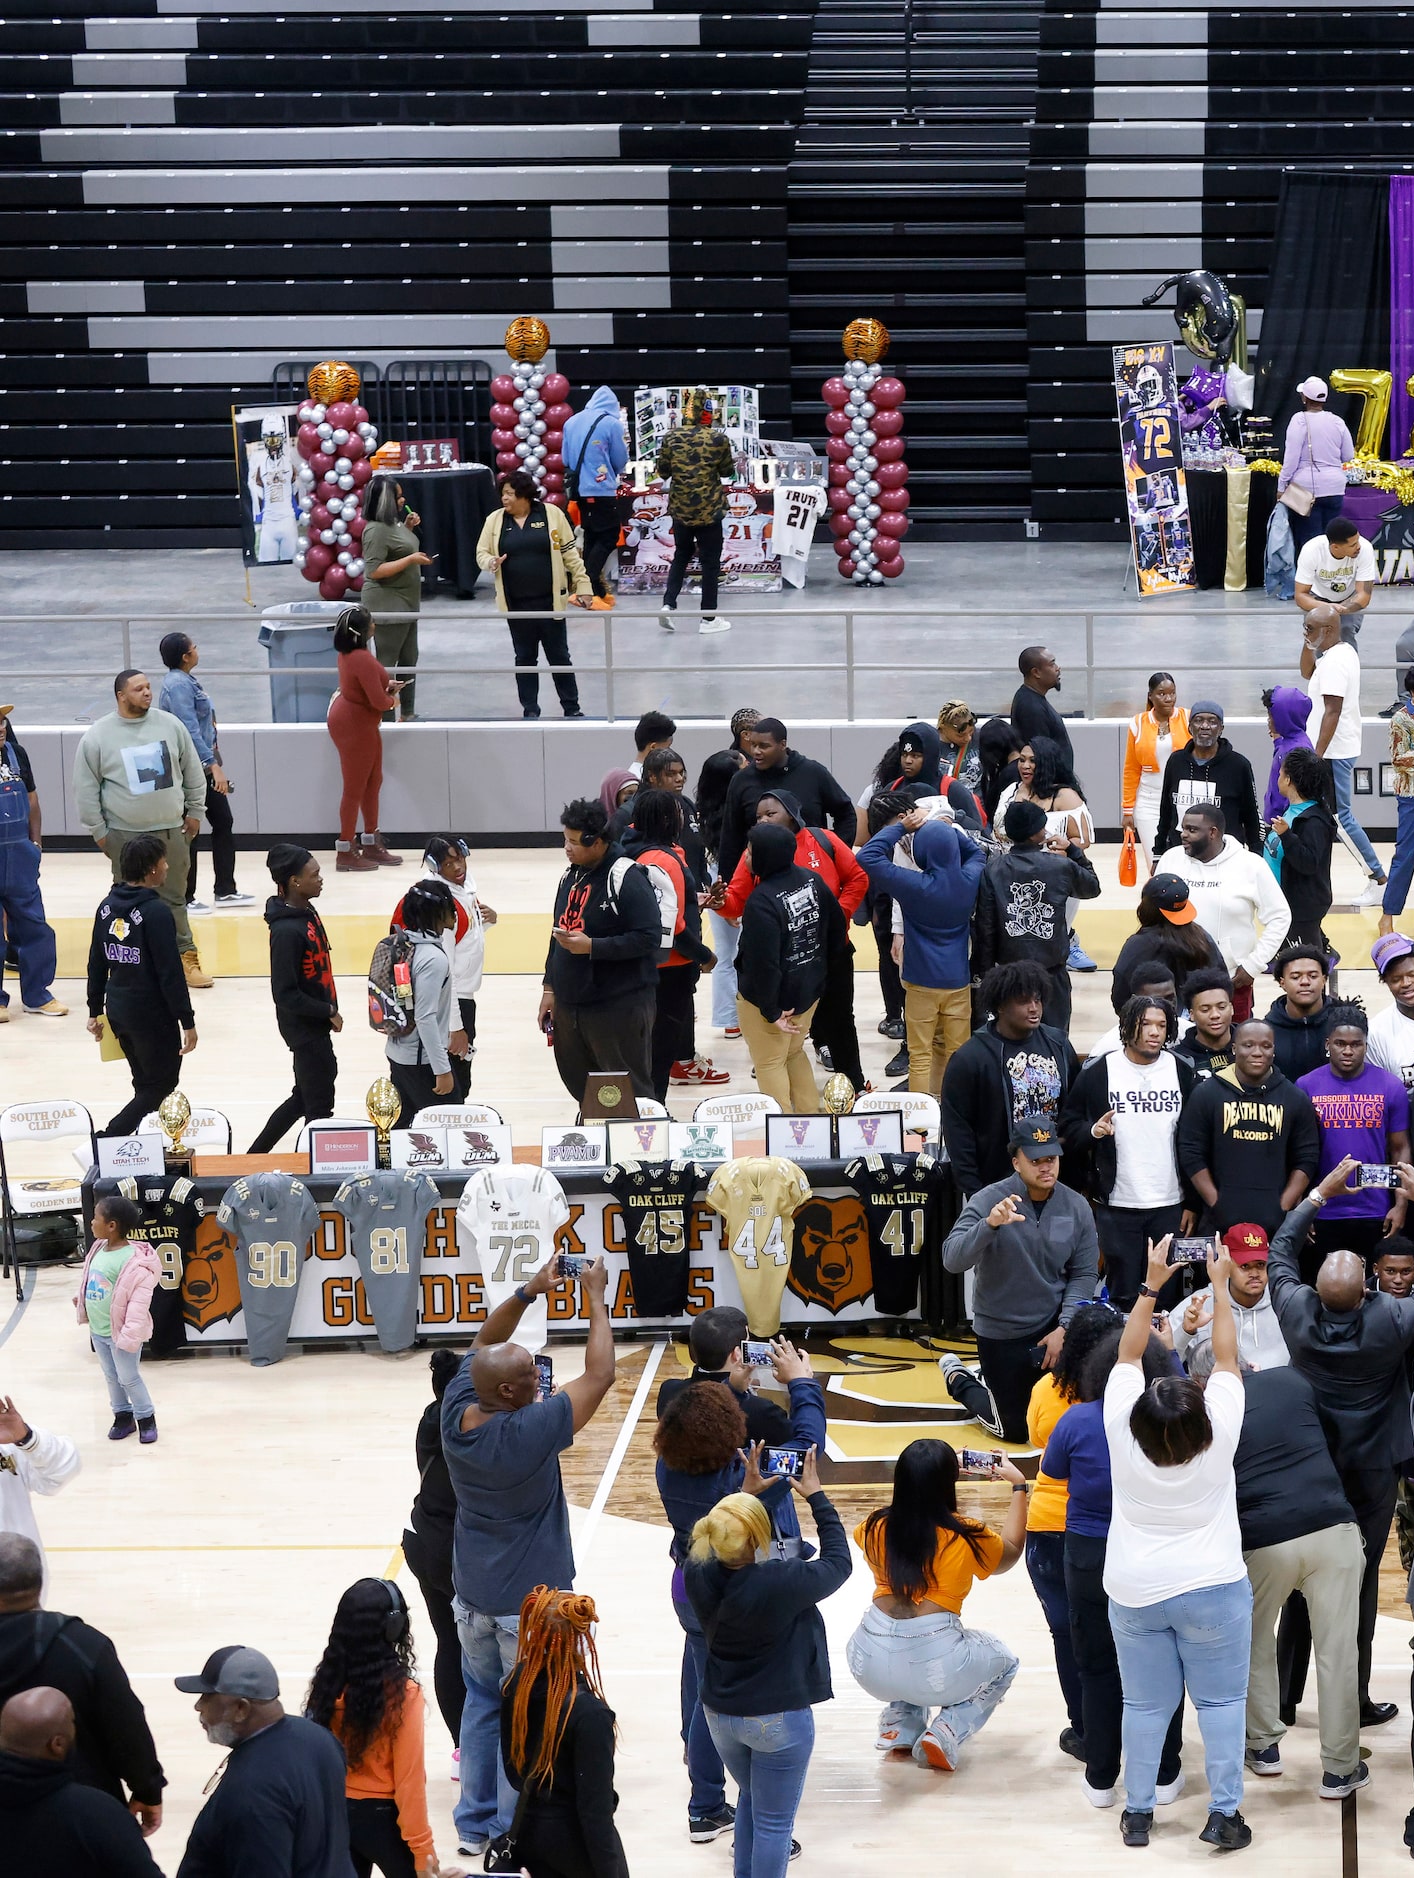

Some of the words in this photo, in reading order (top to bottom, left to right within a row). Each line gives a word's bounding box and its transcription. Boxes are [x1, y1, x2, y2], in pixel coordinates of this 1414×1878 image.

[1139, 416, 1174, 460] 72
[785, 489, 818, 508] TRUTH
[786, 504, 810, 531] 21
[728, 524, 752, 540] 21
[622, 563, 670, 575] TEXA
[1172, 792, 1219, 809] VISIONARY
[1207, 880, 1221, 888] me
[104, 942, 141, 964] LARS
[1110, 1091, 1120, 1102] N
[1126, 1090, 1180, 1102] GLOCK
[1312, 1095, 1352, 1104] MISSOURI
[1353, 1094, 1384, 1103] VALLEY
[640, 1106, 656, 1116] AK
[706, 1103, 742, 1116] SOUTH
[745, 1101, 769, 1112] OAK
[862, 1099, 900, 1110] SOUTH
[904, 1101, 928, 1111] OAK
[1130, 1101, 1181, 1113] TRUST
[10, 1111, 49, 1123] SOUTH
[52, 1108, 78, 1119] OAK
[422, 1113, 460, 1123] SOUTH
[464, 1113, 489, 1123] OAK
[723, 1112, 753, 1122] CLIFF
[1223, 1101, 1257, 1134] DEATH
[1259, 1103, 1284, 1137] ROW
[28, 1119, 61, 1132] CLIFF
[191, 1117, 216, 1128] OAK
[1323, 1120, 1383, 1129] OLLEGE
[1233, 1129, 1274, 1141] RECORDS
[131, 1156, 150, 1164] TECH
[409, 1152, 442, 1162] ULM
[465, 1151, 498, 1161] ULM
[548, 1145, 601, 1162] PVAMU
[30, 1199, 65, 1209] GOLDEN
[629, 1196, 652, 1208] OAK
[655, 1194, 685, 1207] CLIFF
[871, 1193, 895, 1206] OAK
[897, 1192, 929, 1204] CLIFF
[749, 1204, 767, 1217] SOC
[491, 1221, 508, 1230] THE
[511, 1219, 541, 1230] MECCA
[126, 1228, 149, 1240] OAK
[150, 1226, 179, 1239] CLIFF
[635, 1209, 686, 1255] 45
[880, 1209, 925, 1256] 41
[732, 1215, 788, 1270] 44
[370, 1226, 409, 1274] 81
[489, 1234, 541, 1282] 72
[247, 1241, 297, 1289] 90
